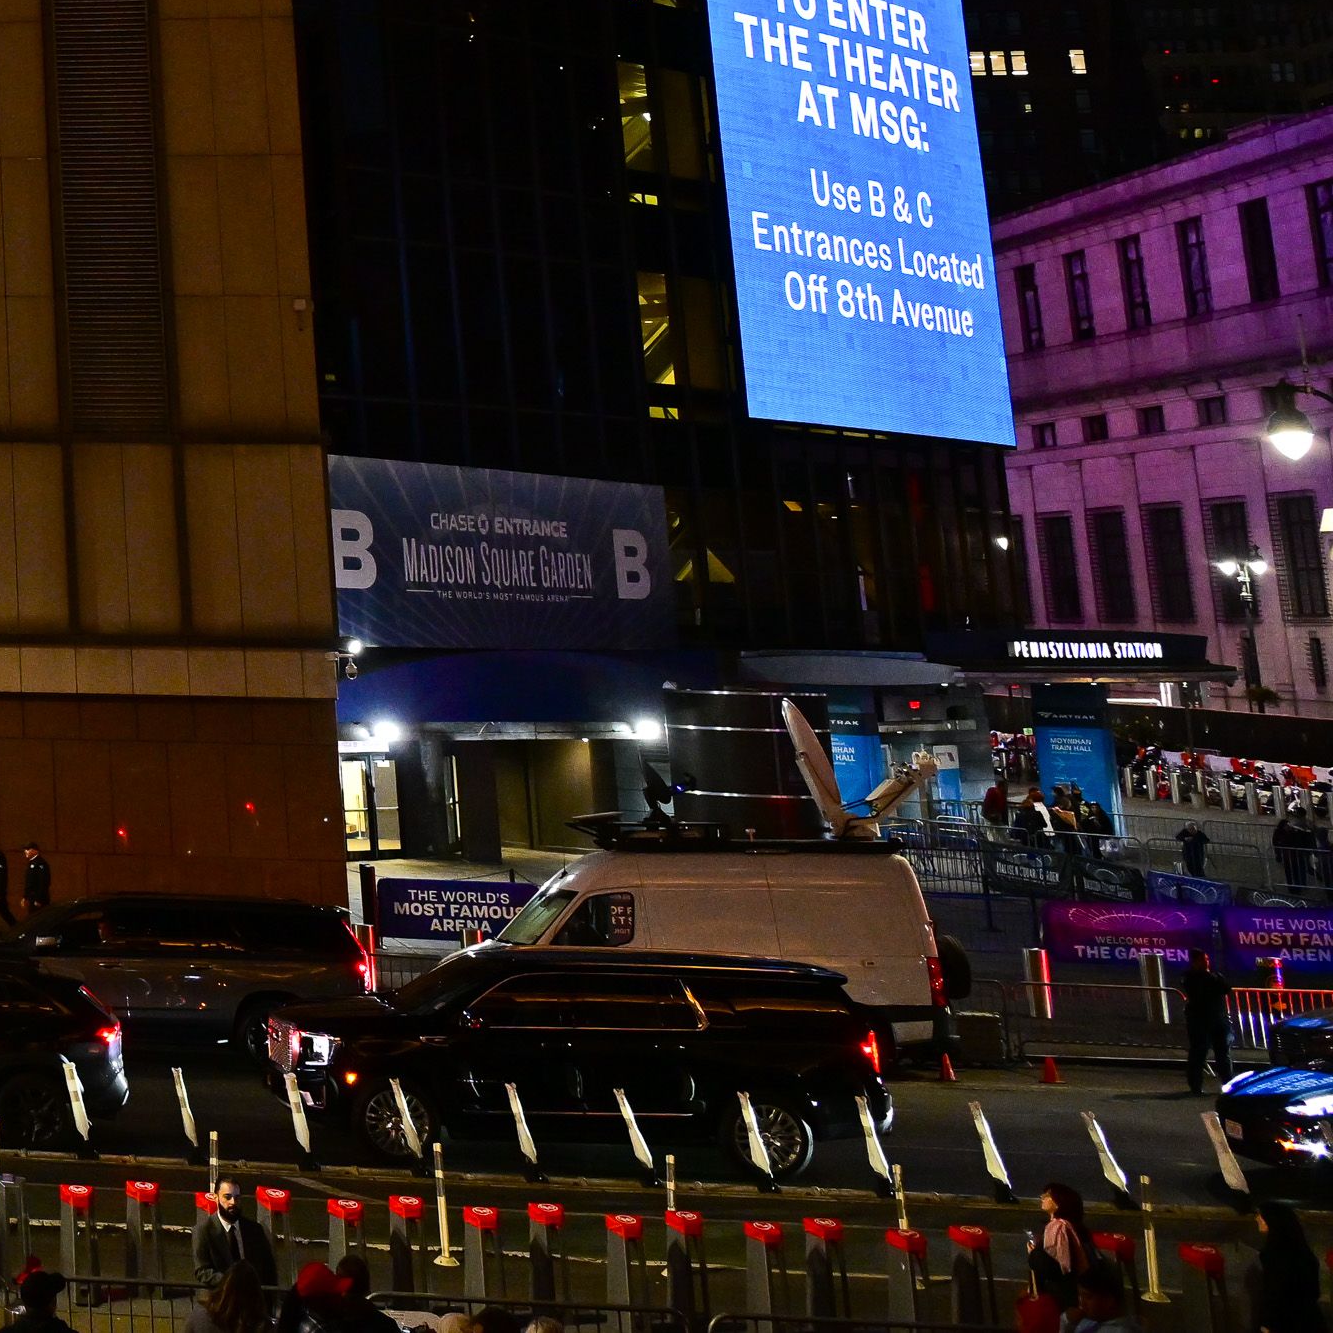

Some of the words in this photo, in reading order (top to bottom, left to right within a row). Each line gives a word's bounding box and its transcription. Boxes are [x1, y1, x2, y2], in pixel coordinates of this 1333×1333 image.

[734, 11, 812, 72] THE
[818, 32, 961, 114] THEATER
[797, 79, 840, 130] AT
[849, 91, 931, 153] MSG:
[809, 167, 862, 214] Use
[867, 179, 887, 219] B
[892, 185, 914, 225] &
[916, 190, 935, 229] C
[751, 210, 894, 272] Entrances
[897, 236, 986, 290] Located
[784, 270, 829, 315] Off
[835, 278, 885, 323] 8th
[891, 288, 976, 338] Avenue
[430, 512, 476, 533] CHASE
[494, 516, 568, 539] ENTRANCE
[330, 508, 378, 590] B
[401, 536, 477, 585] MADISON
[480, 540, 535, 589] SQUARE
[539, 544, 593, 591] GARDEN
[612, 528, 652, 601] B
[436, 590, 453, 600] THE
[1012, 640, 1112, 660] PENNSYLVANIA
[1113, 641, 1164, 659] STATION
[407, 889, 438, 902] THE
[441, 890, 511, 905] WORLD'S
[393, 901, 446, 918] MOST
[430, 917, 493, 934] ARENA
[1251, 917, 1286, 931] THE
[1288, 918, 1333, 932] WORL
[1094, 935, 1150, 946] WELCOME
[1152, 937, 1167, 947] TO
[1238, 931, 1294, 946] MOST
[1298, 932, 1333, 947] FAM
[1073, 945, 1112, 960] THE
[1278, 947, 1333, 963] AREN
